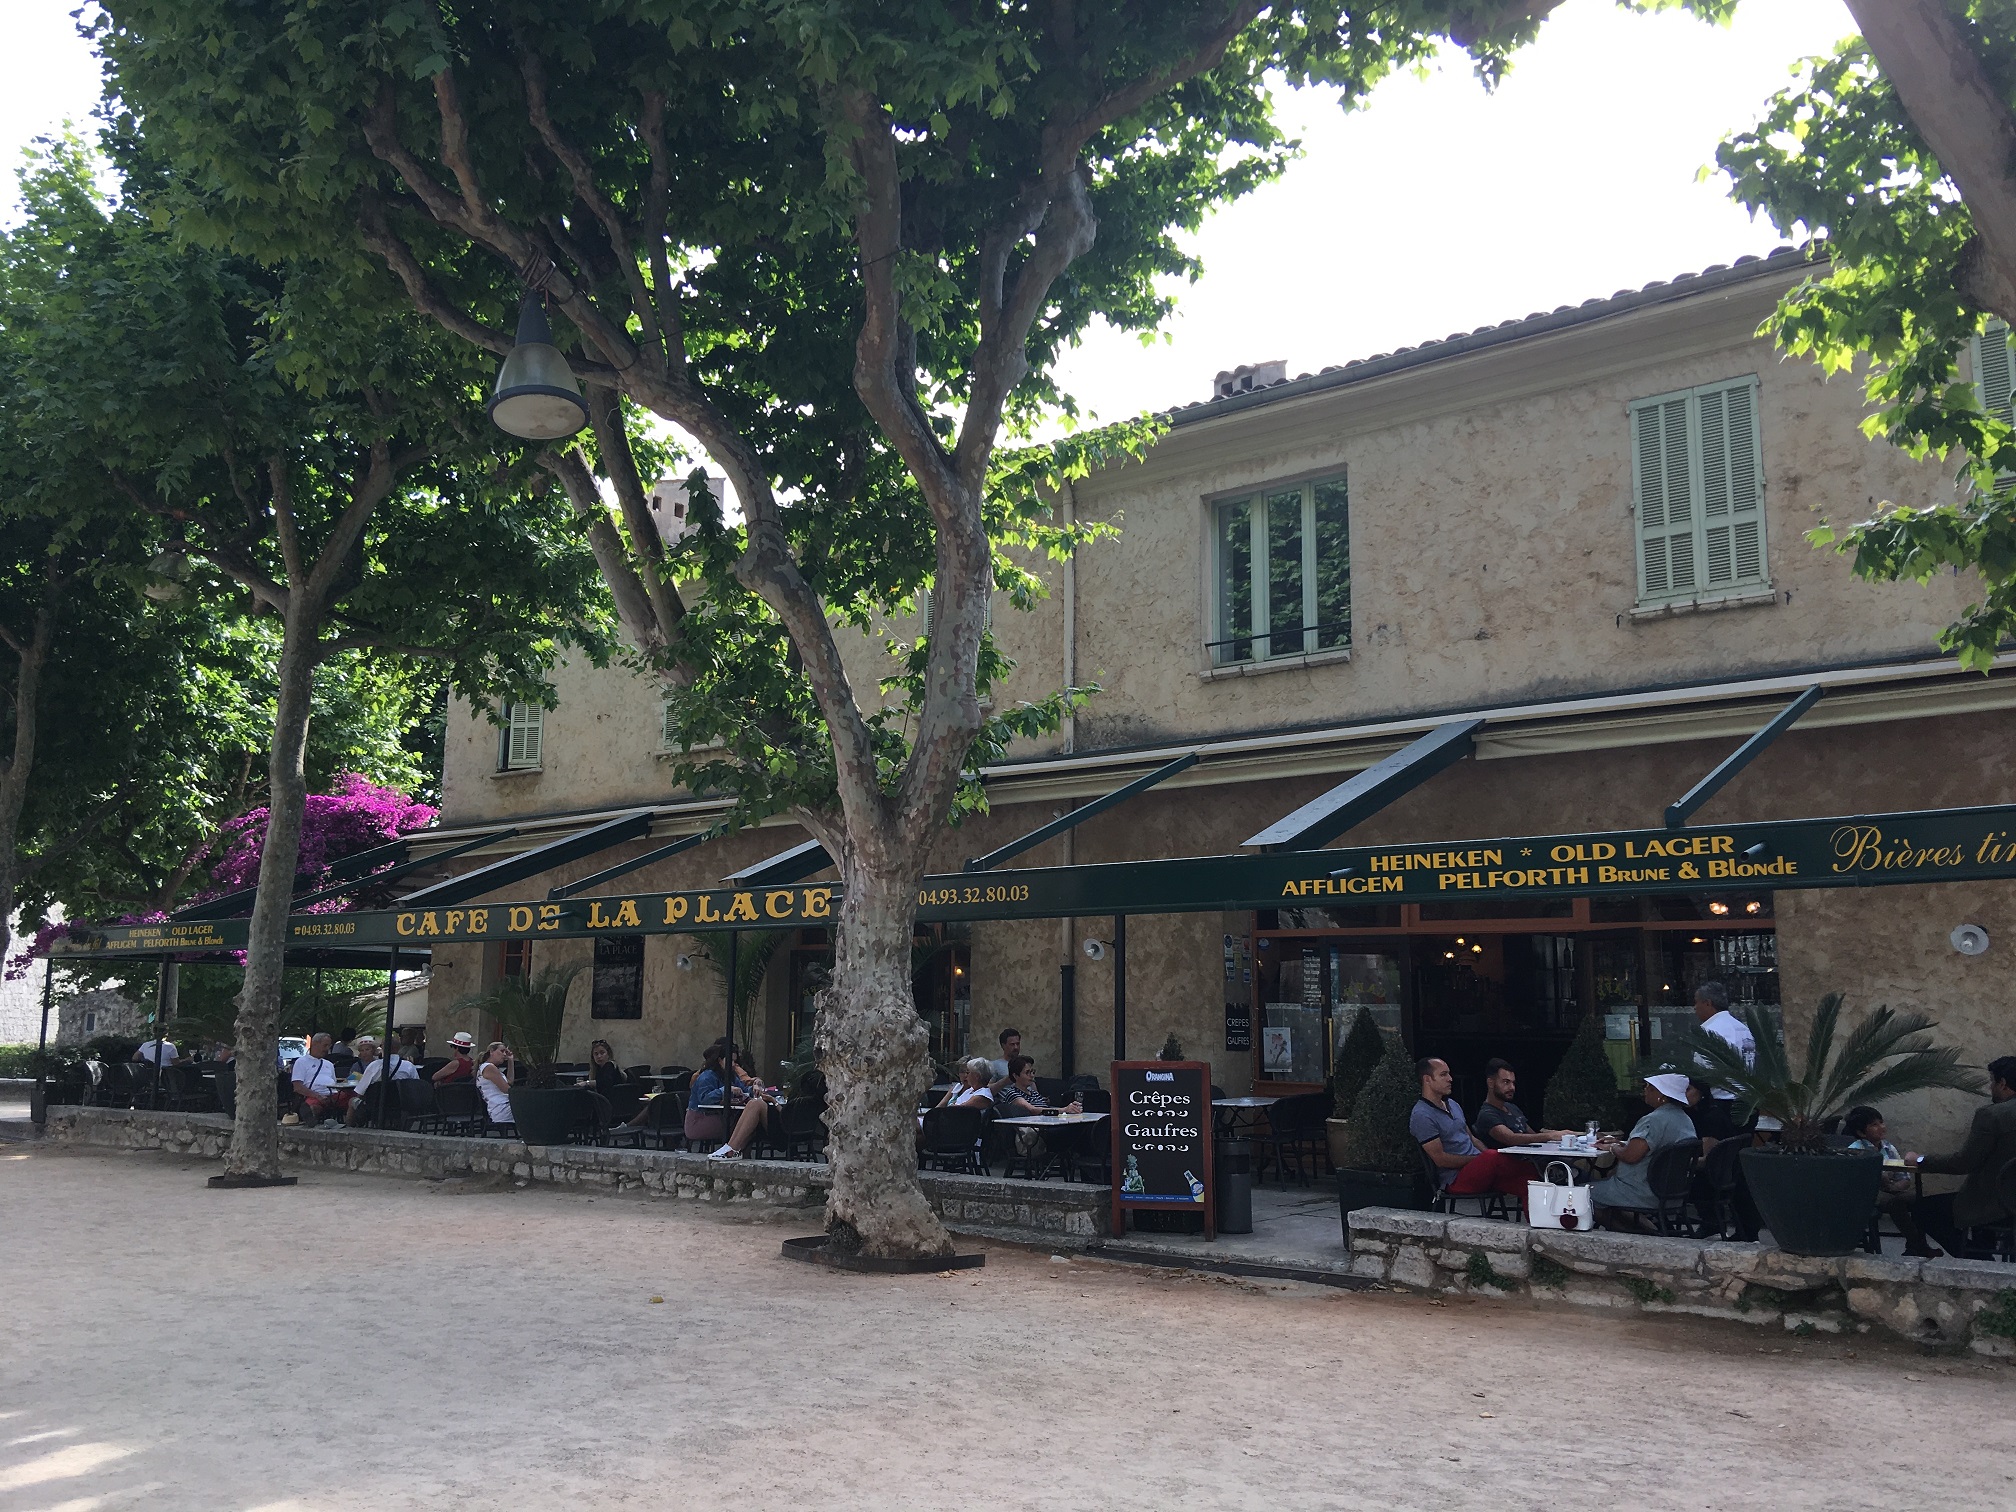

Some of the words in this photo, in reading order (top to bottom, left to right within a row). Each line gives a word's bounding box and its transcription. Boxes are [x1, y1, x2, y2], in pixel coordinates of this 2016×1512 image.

[1371, 849, 1502, 872] HEINEKEN
[1551, 843, 1616, 862] OLD
[1625, 836, 1734, 858] LAGER
[1830, 825, 1965, 873] Bières
[1281, 876, 1403, 895] AFFLIGEM
[1439, 866, 1589, 890] PELFORTH
[1678, 861, 1700, 879] &
[918, 885, 1029, 906] 04.93.32.80.03
[396, 909, 489, 936] CAFE
[508, 905, 561, 932] DE
[586, 900, 641, 928] LA
[662, 888, 832, 924] PLACE
[129, 928, 161, 938] HEINEKEN
[172, 926, 188, 936] OLD
[188, 925, 214, 935] LAGER
[301, 922, 355, 936] 04.93.32.80.03
[105, 939, 137, 950] AFFLIGEM
[143, 937, 180, 948] PELFORTH
[613, 945, 638, 955] PLACE
[1226, 1018, 1250, 1027] CREPES
[1227, 1036, 1250, 1045] GAUFRES
[1129, 1090, 1191, 1108] Crêpes
[1124, 1123, 1198, 1138] Gaufres
